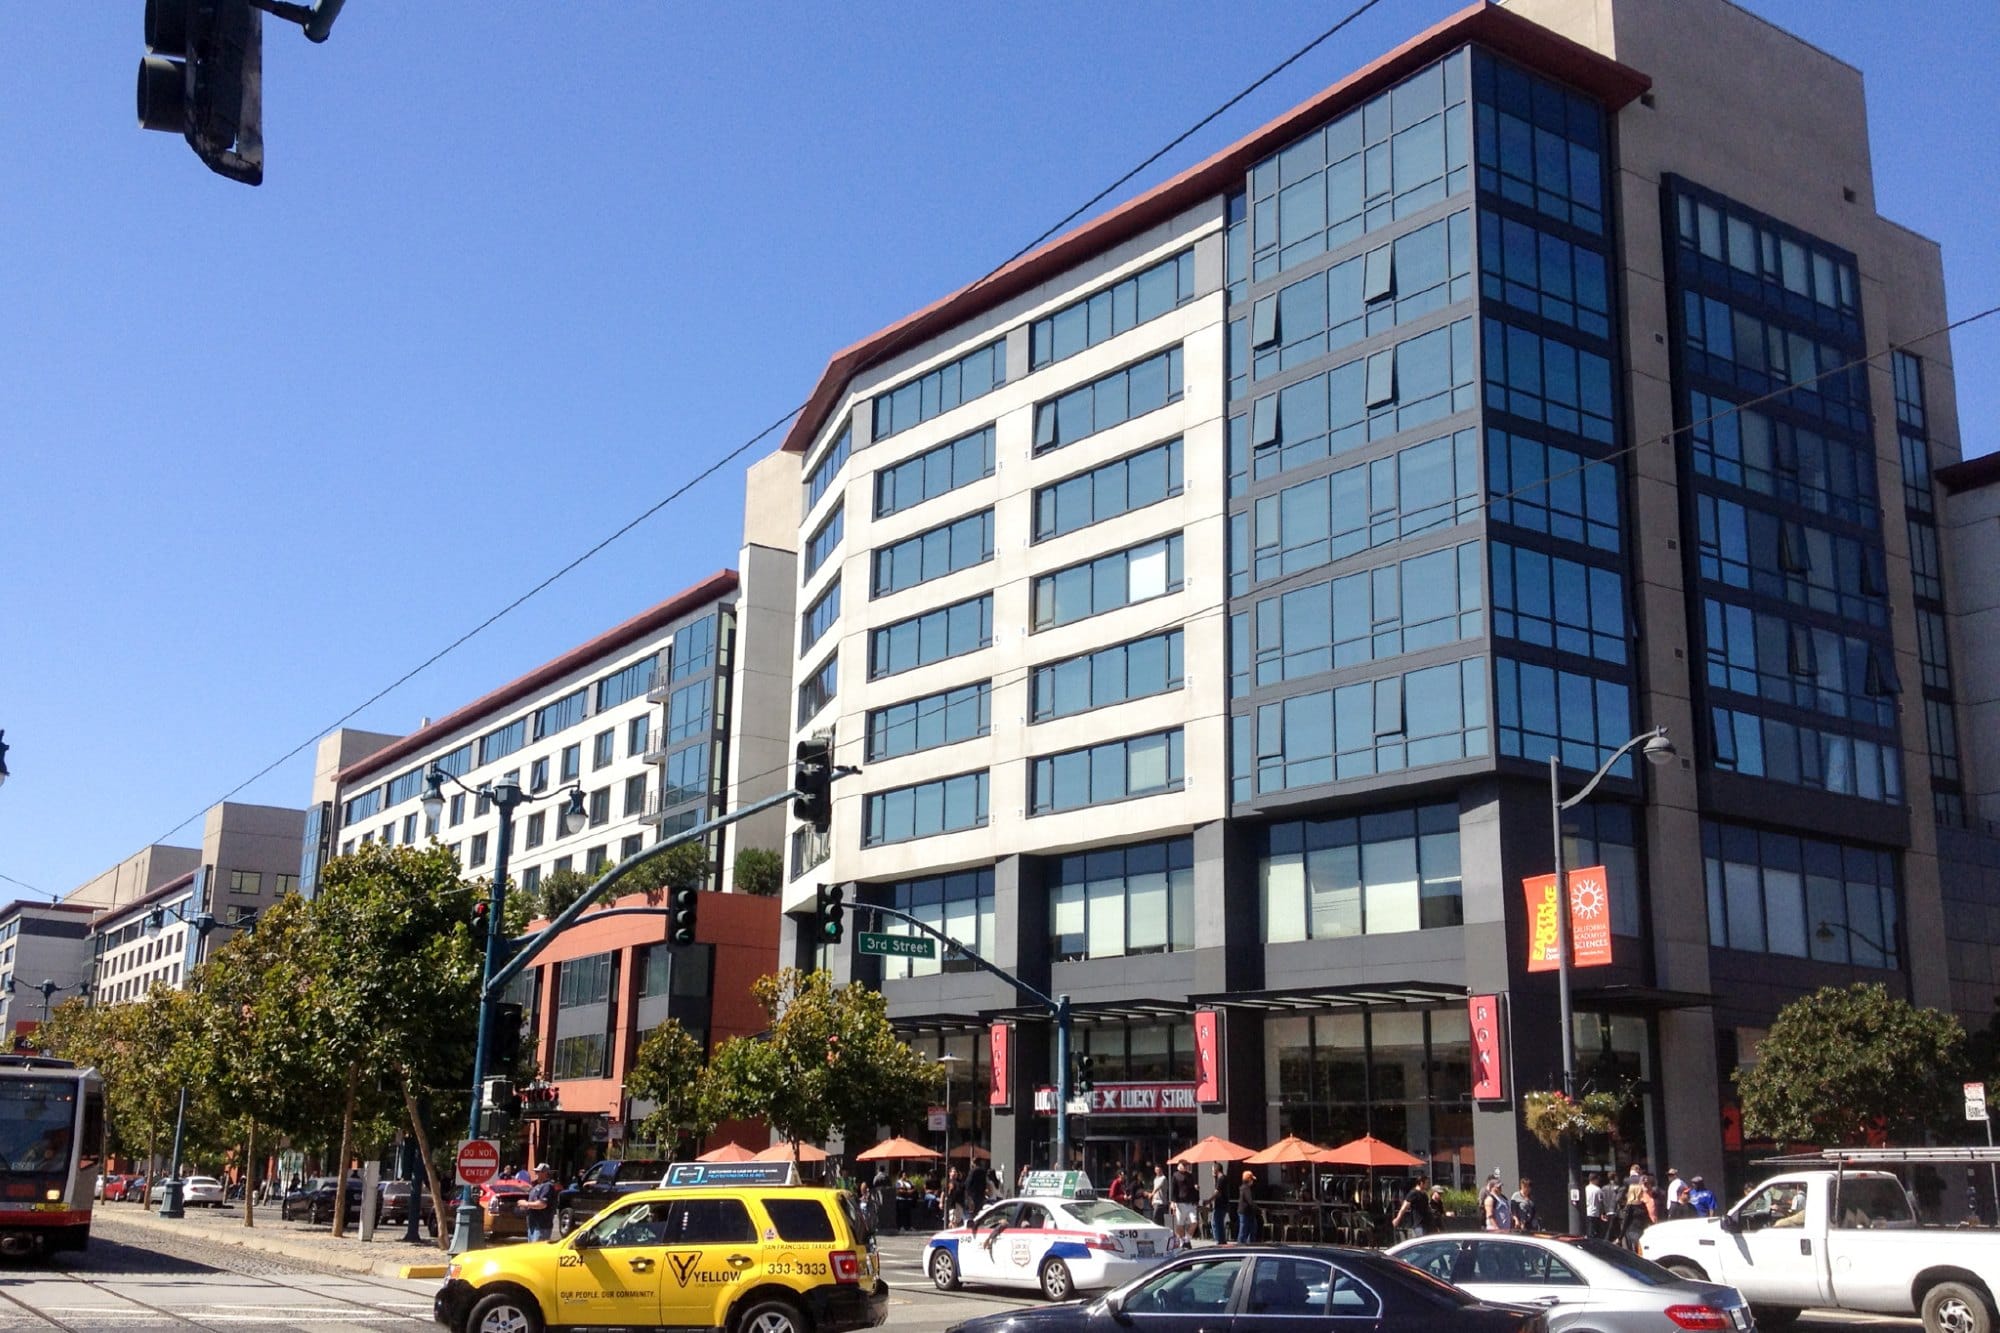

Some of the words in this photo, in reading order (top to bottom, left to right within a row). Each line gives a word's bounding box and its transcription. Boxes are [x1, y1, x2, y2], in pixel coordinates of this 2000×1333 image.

[867, 938, 887, 950] 3rd
[893, 940, 928, 953] Street
[1574, 939, 1609, 949] SCIENCES
[1121, 1090, 1157, 1108] LUCKY
[1161, 1089, 1196, 1108] STRIK
[1119, 1229, 1138, 1239] S-10
[560, 1255, 584, 1267] 1224
[768, 1263, 826, 1275] 333-3333
[694, 1271, 742, 1282] YELLOW
